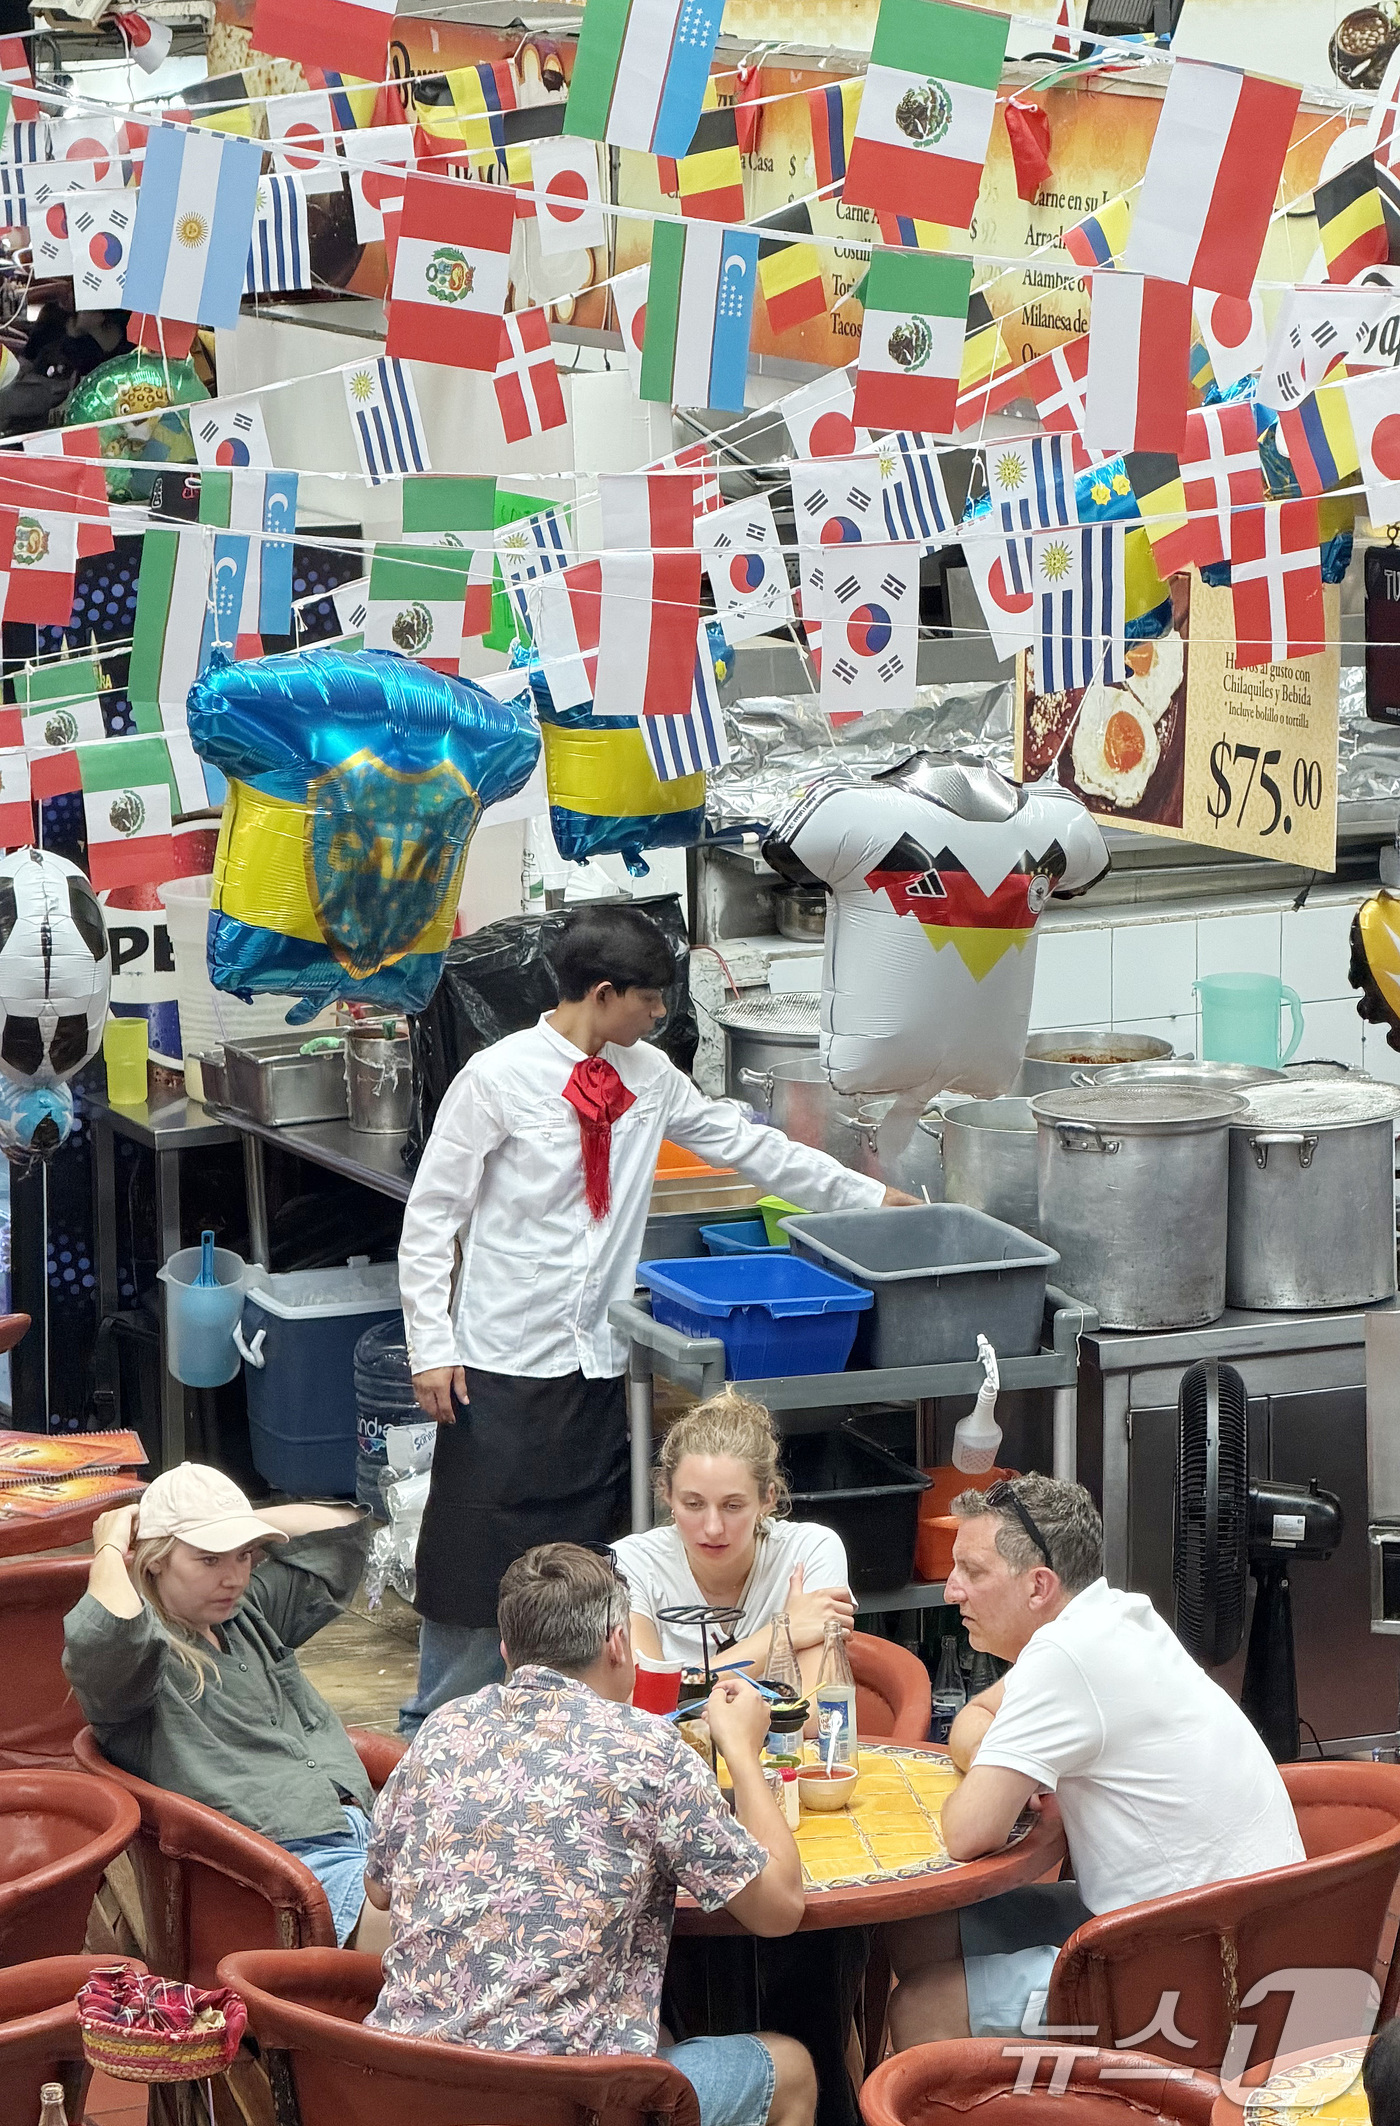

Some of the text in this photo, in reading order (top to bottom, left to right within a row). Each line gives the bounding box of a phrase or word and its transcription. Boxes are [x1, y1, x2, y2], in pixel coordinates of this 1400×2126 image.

[748, 151, 774, 172] Casa
[836, 198, 870, 223] Carne
[1067, 195, 1082, 211] en
[1085, 196, 1099, 212] su
[1022, 268, 1075, 292] Alambre
[831, 313, 862, 338] Tacos
[1021, 303, 1088, 333] Milanesa de
[1225, 651, 1259, 674] Hos
[1270, 662, 1293, 683] gusto
[1295, 669, 1311, 683] con
[1223, 674, 1312, 706] Chilaquiles y Bebida
[1228, 701, 1309, 729] Incluye bolillo o tortilla
[1206, 731, 1323, 837] $75.00
